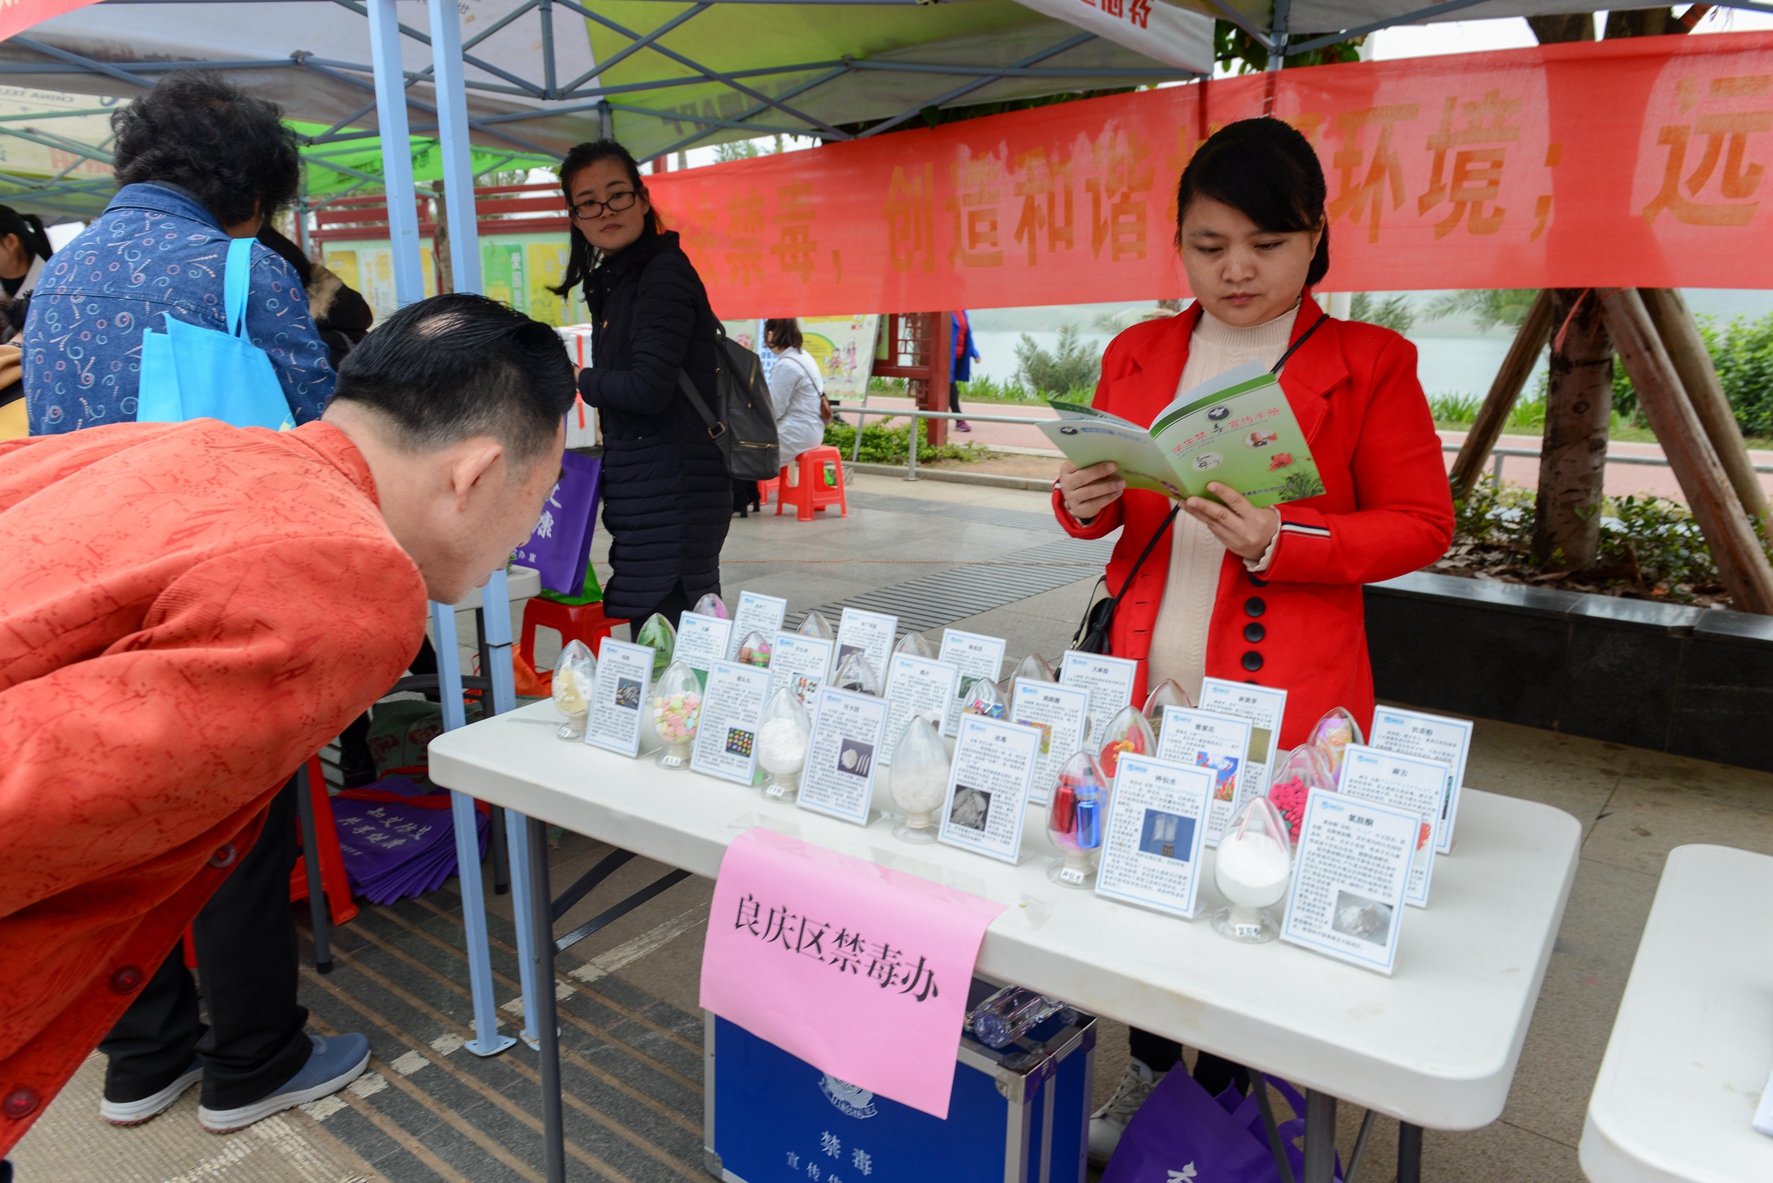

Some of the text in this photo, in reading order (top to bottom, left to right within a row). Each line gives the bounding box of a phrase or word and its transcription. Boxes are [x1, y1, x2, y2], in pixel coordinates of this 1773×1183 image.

[1155, 774, 1176, 786] 神仙水
[1348, 813, 1375, 827] 氯胺酮
[734, 893, 939, 1003] 良庆区禁毒办
[820, 1130, 873, 1176] 禁毒
